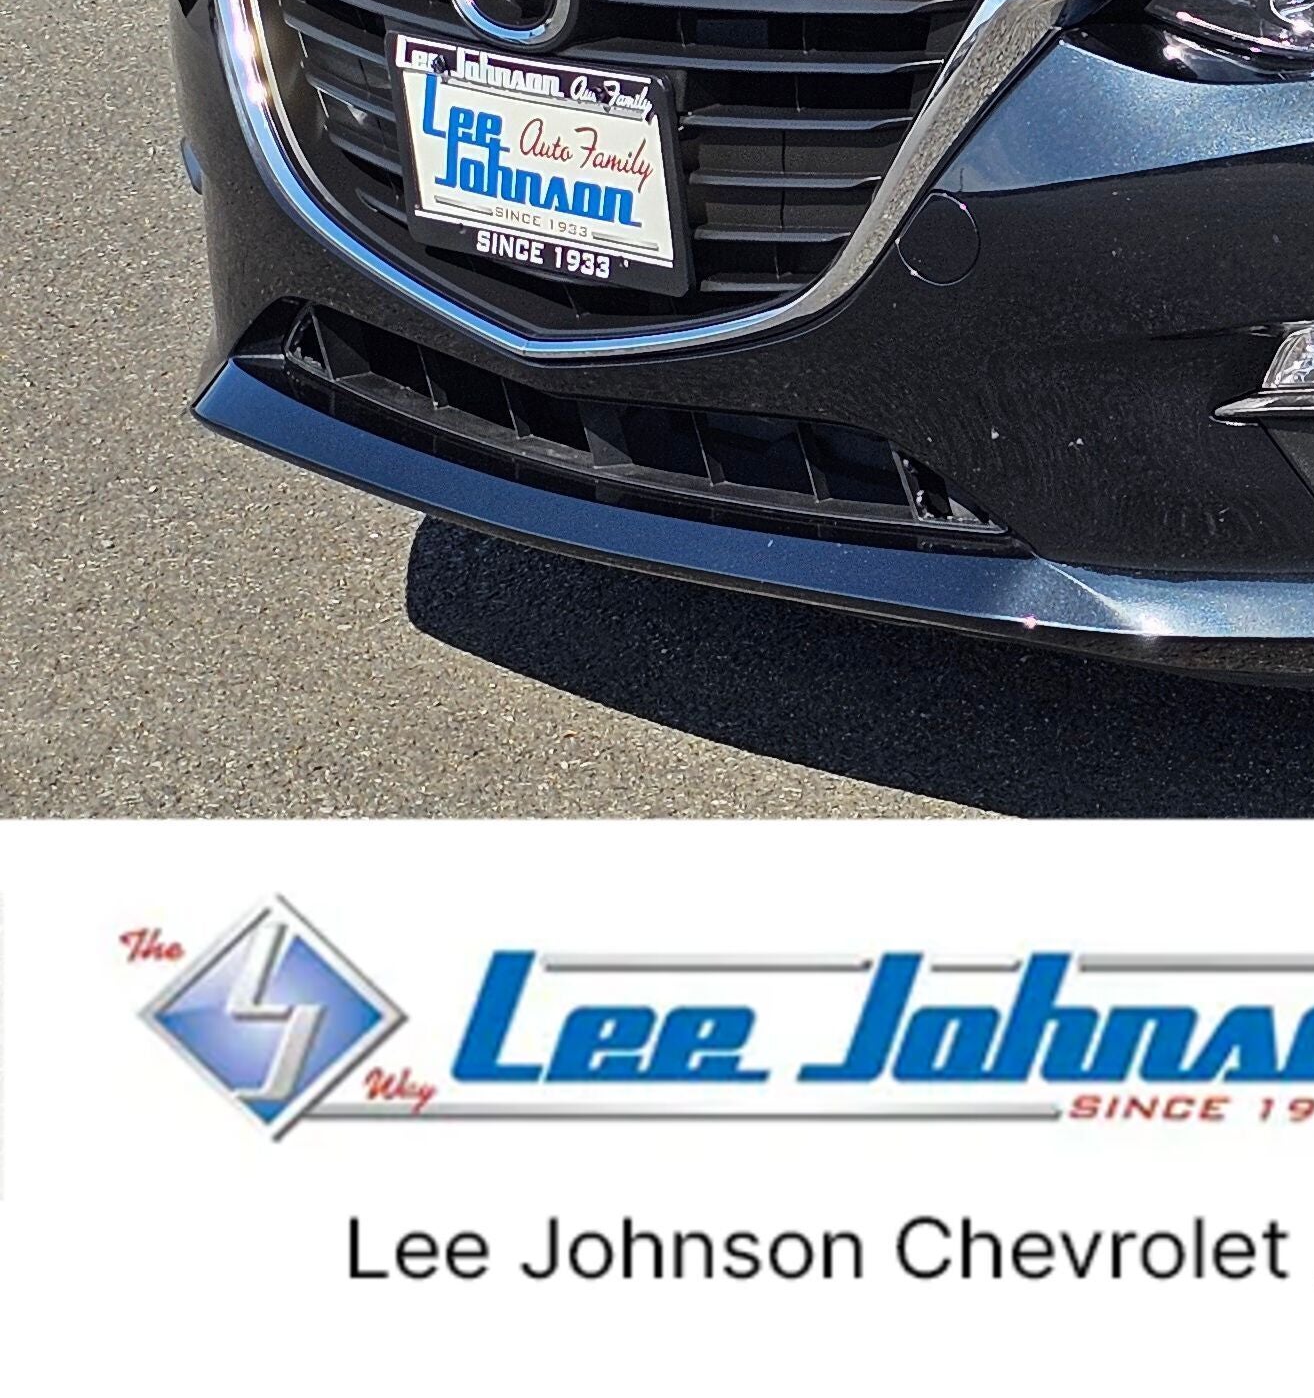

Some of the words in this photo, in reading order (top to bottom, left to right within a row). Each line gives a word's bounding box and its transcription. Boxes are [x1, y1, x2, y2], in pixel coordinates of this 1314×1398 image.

[422, 73, 510, 153] Lee
[519, 117, 574, 163] Auto
[574, 126, 654, 193] Family
[434, 140, 643, 229] Johnson
[476, 230, 545, 265] SINCE
[554, 246, 610, 279] 1933
[494, 205, 542, 228] SINCE
[549, 218, 589, 238] 1933
